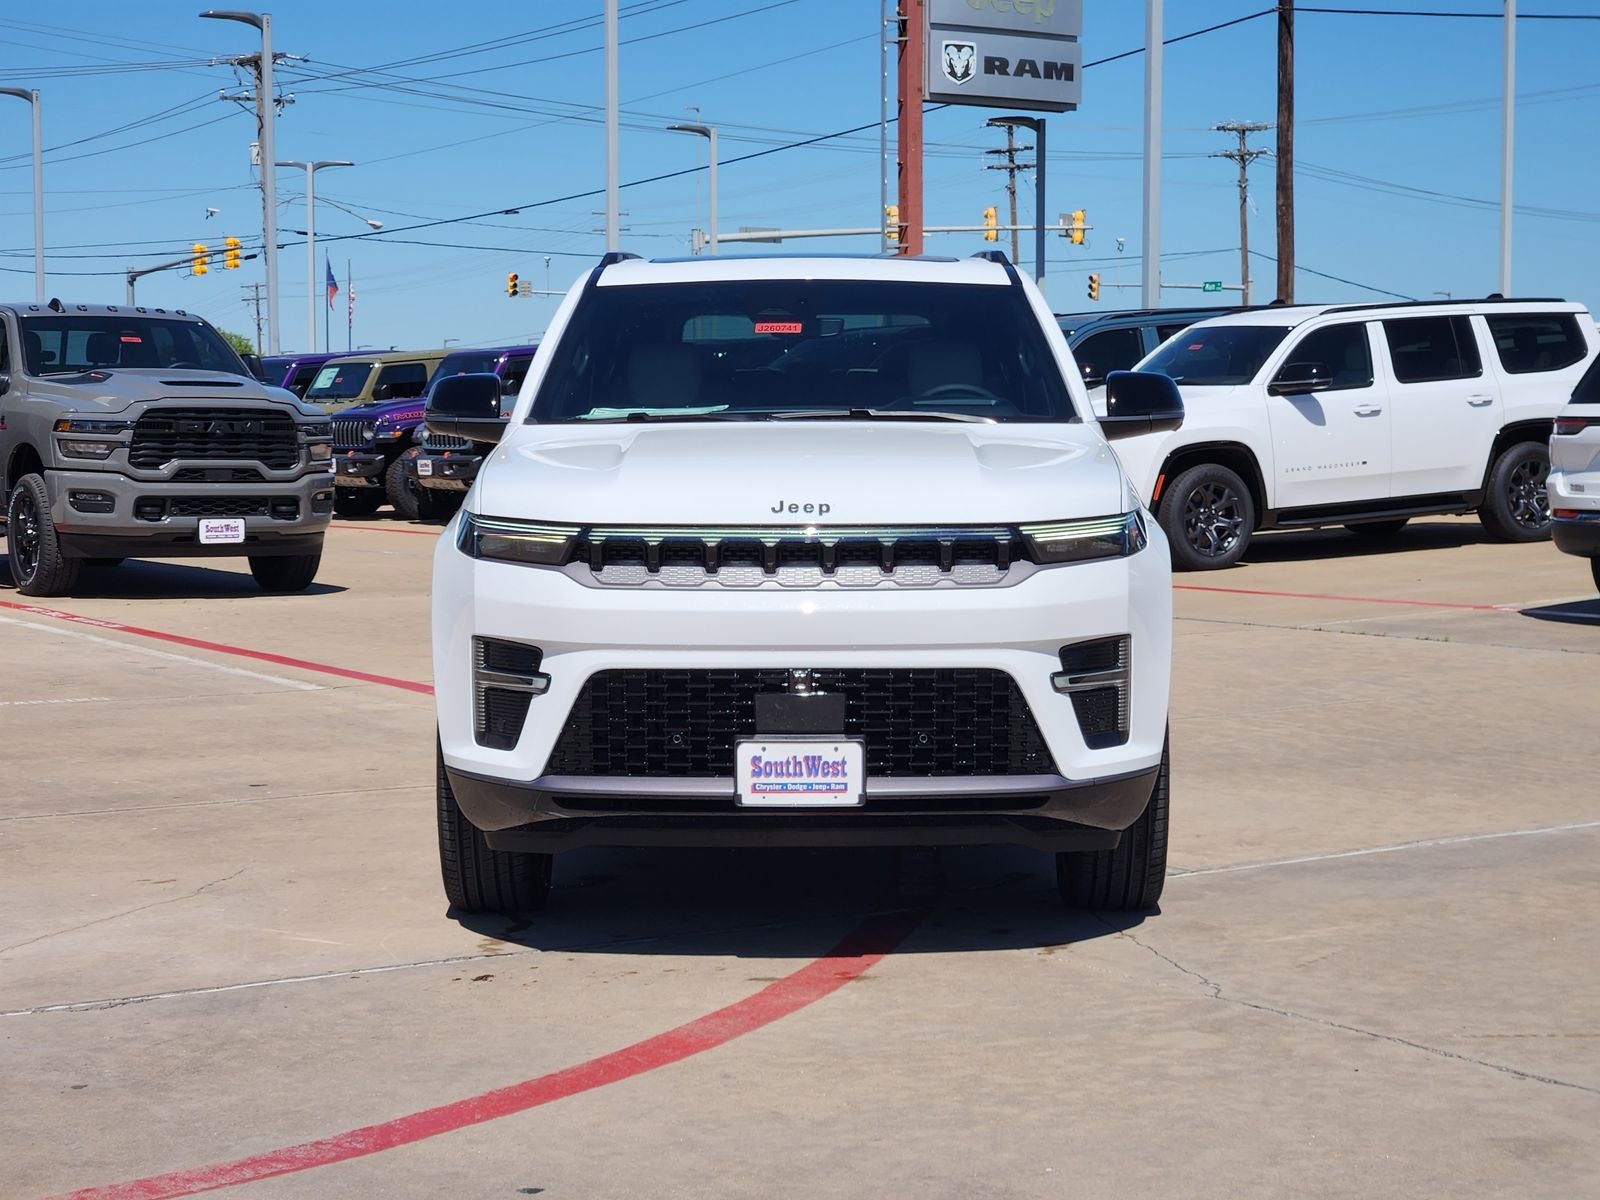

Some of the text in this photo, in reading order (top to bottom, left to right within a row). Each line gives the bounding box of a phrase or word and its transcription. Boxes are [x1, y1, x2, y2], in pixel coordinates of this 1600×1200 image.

[984, 56, 1074, 82] RAM
[757, 324, 798, 332] J260741
[771, 500, 831, 516] Jeep
[750, 755, 848, 779] SouthWest
[755, 783, 782, 791] Chrysler
[787, 783, 808, 791] Dodge
[812, 783, 827, 791] Jeep
